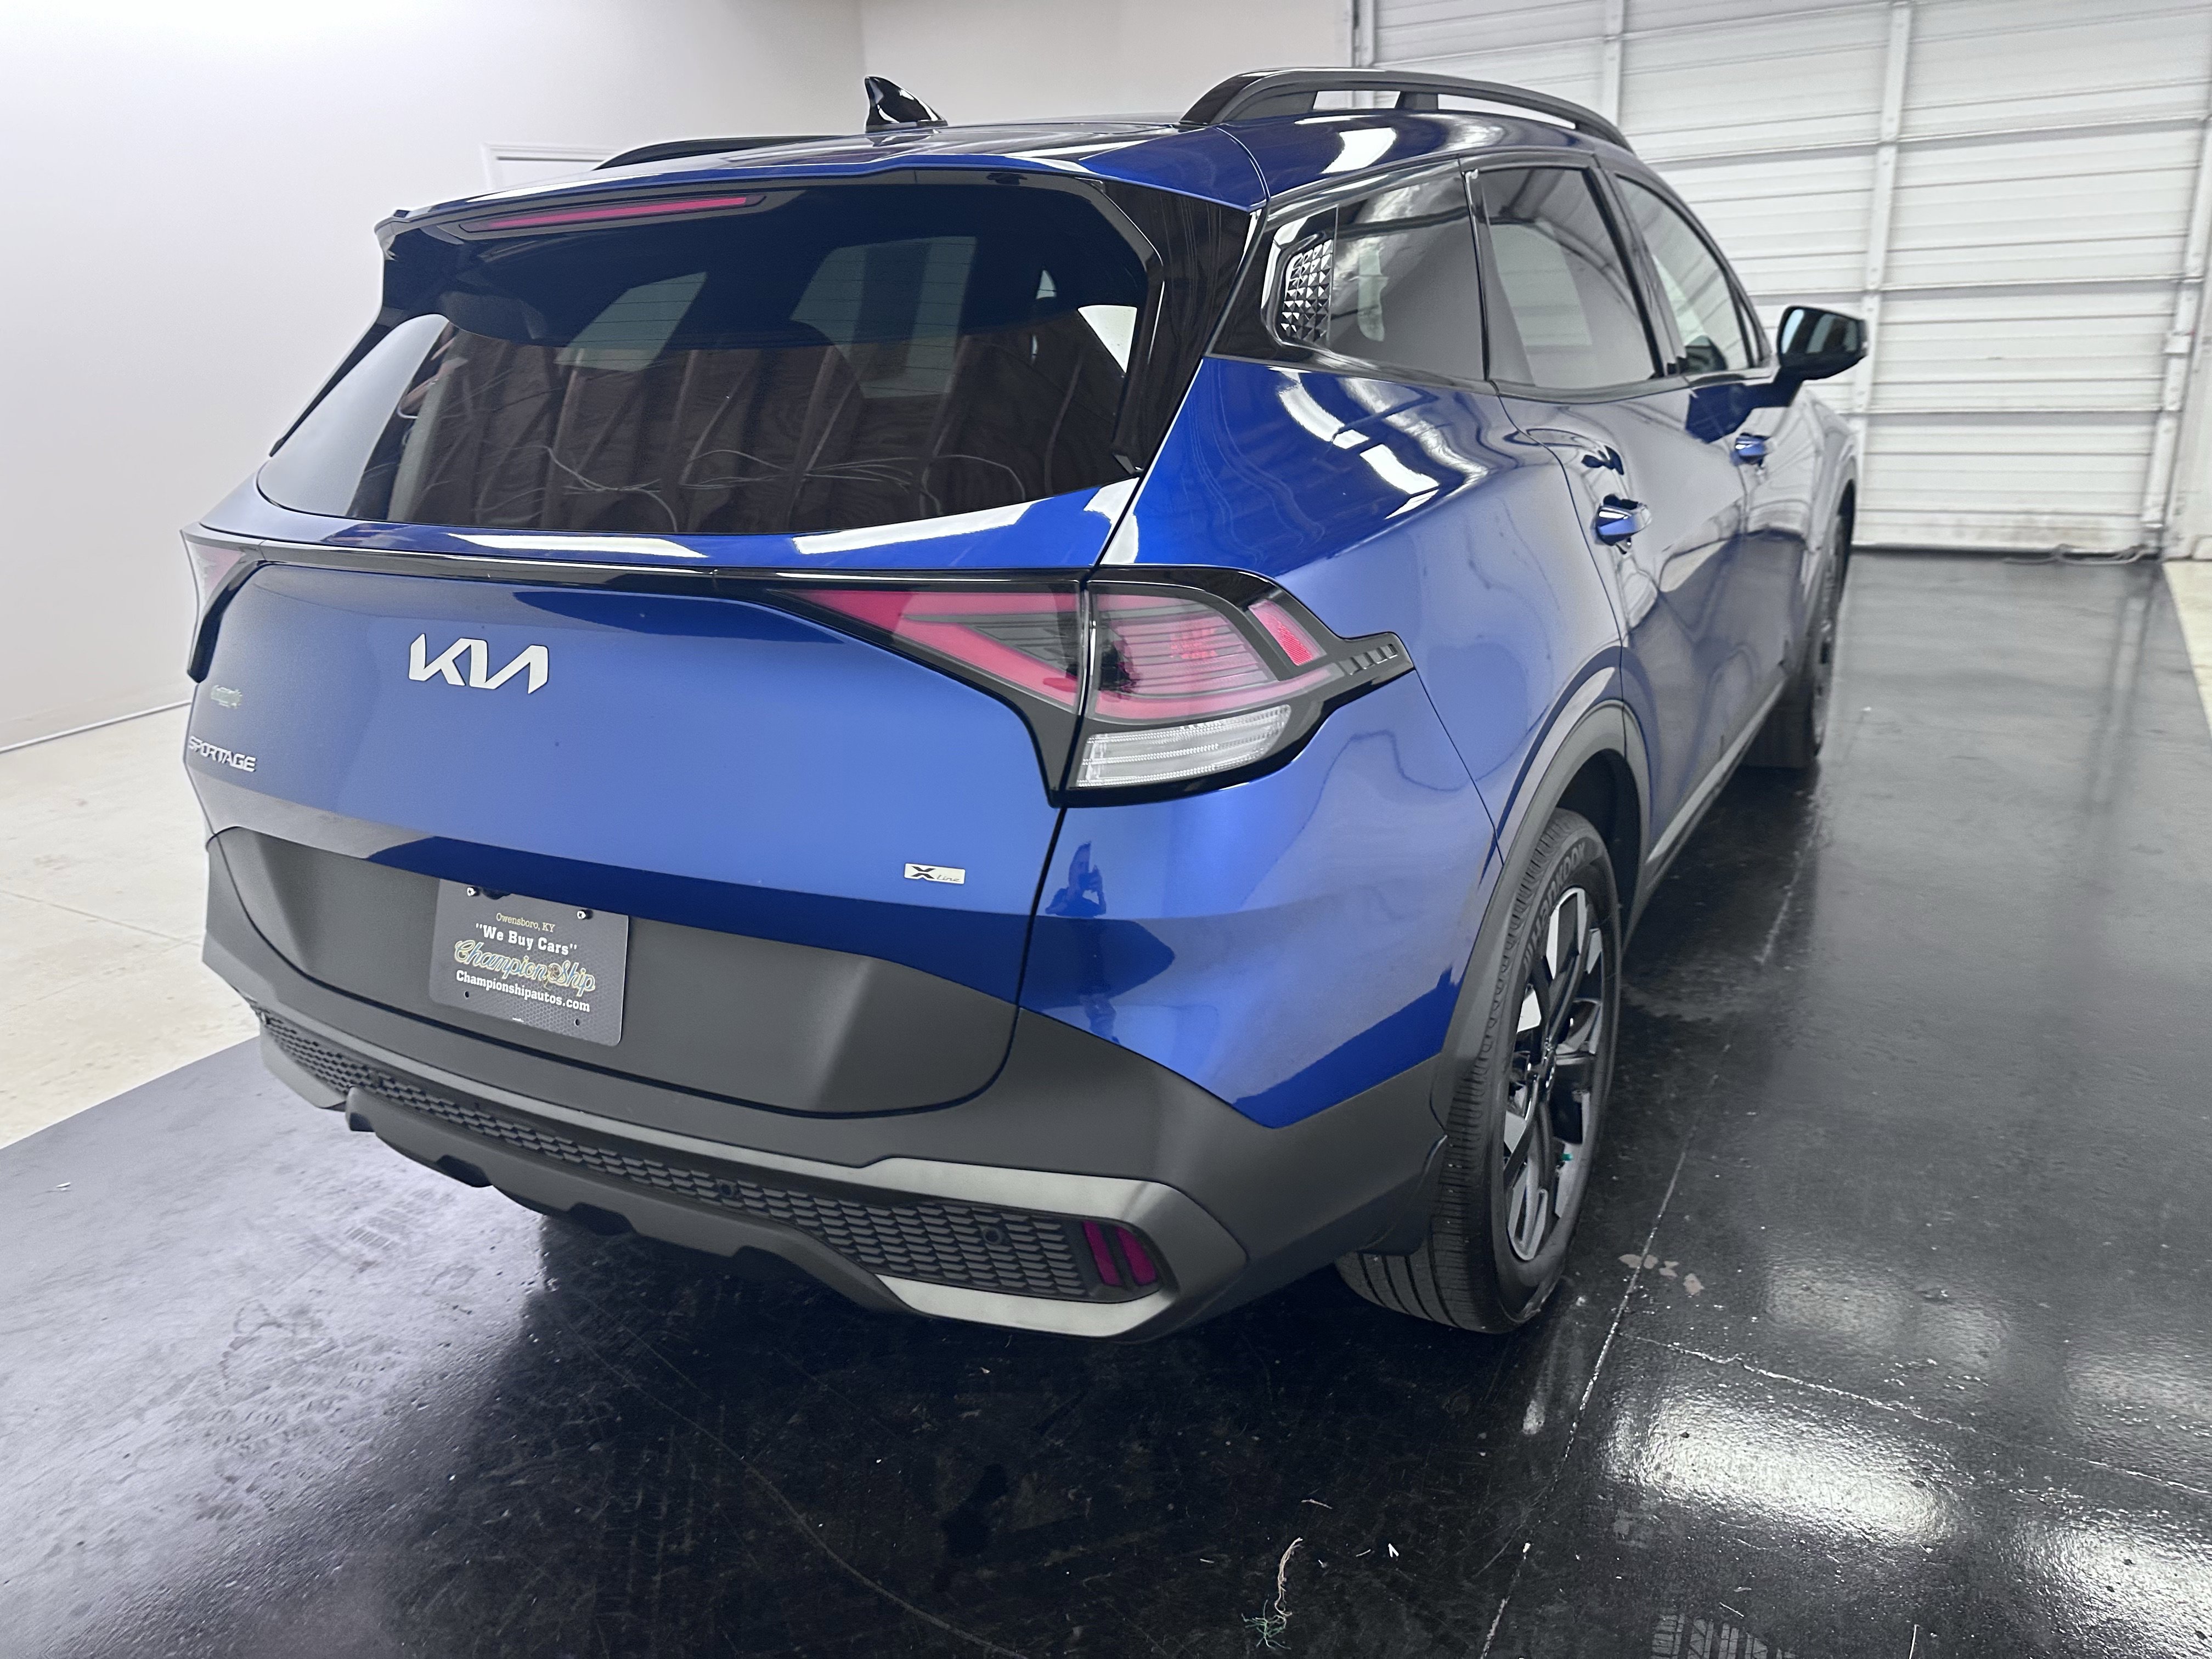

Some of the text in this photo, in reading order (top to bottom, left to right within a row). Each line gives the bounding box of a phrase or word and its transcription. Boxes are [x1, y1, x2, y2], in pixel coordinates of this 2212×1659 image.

[409, 633, 549, 695] KIA
[188, 735, 257, 772] SPORTAGE
[910, 866, 936, 879] X
[476, 923, 577, 956] "We Buy Cars"
[496, 912, 556, 933] Owensboro, KY
[454, 939, 547, 981] Champion
[456, 969, 591, 1012] Championshipautos.com
